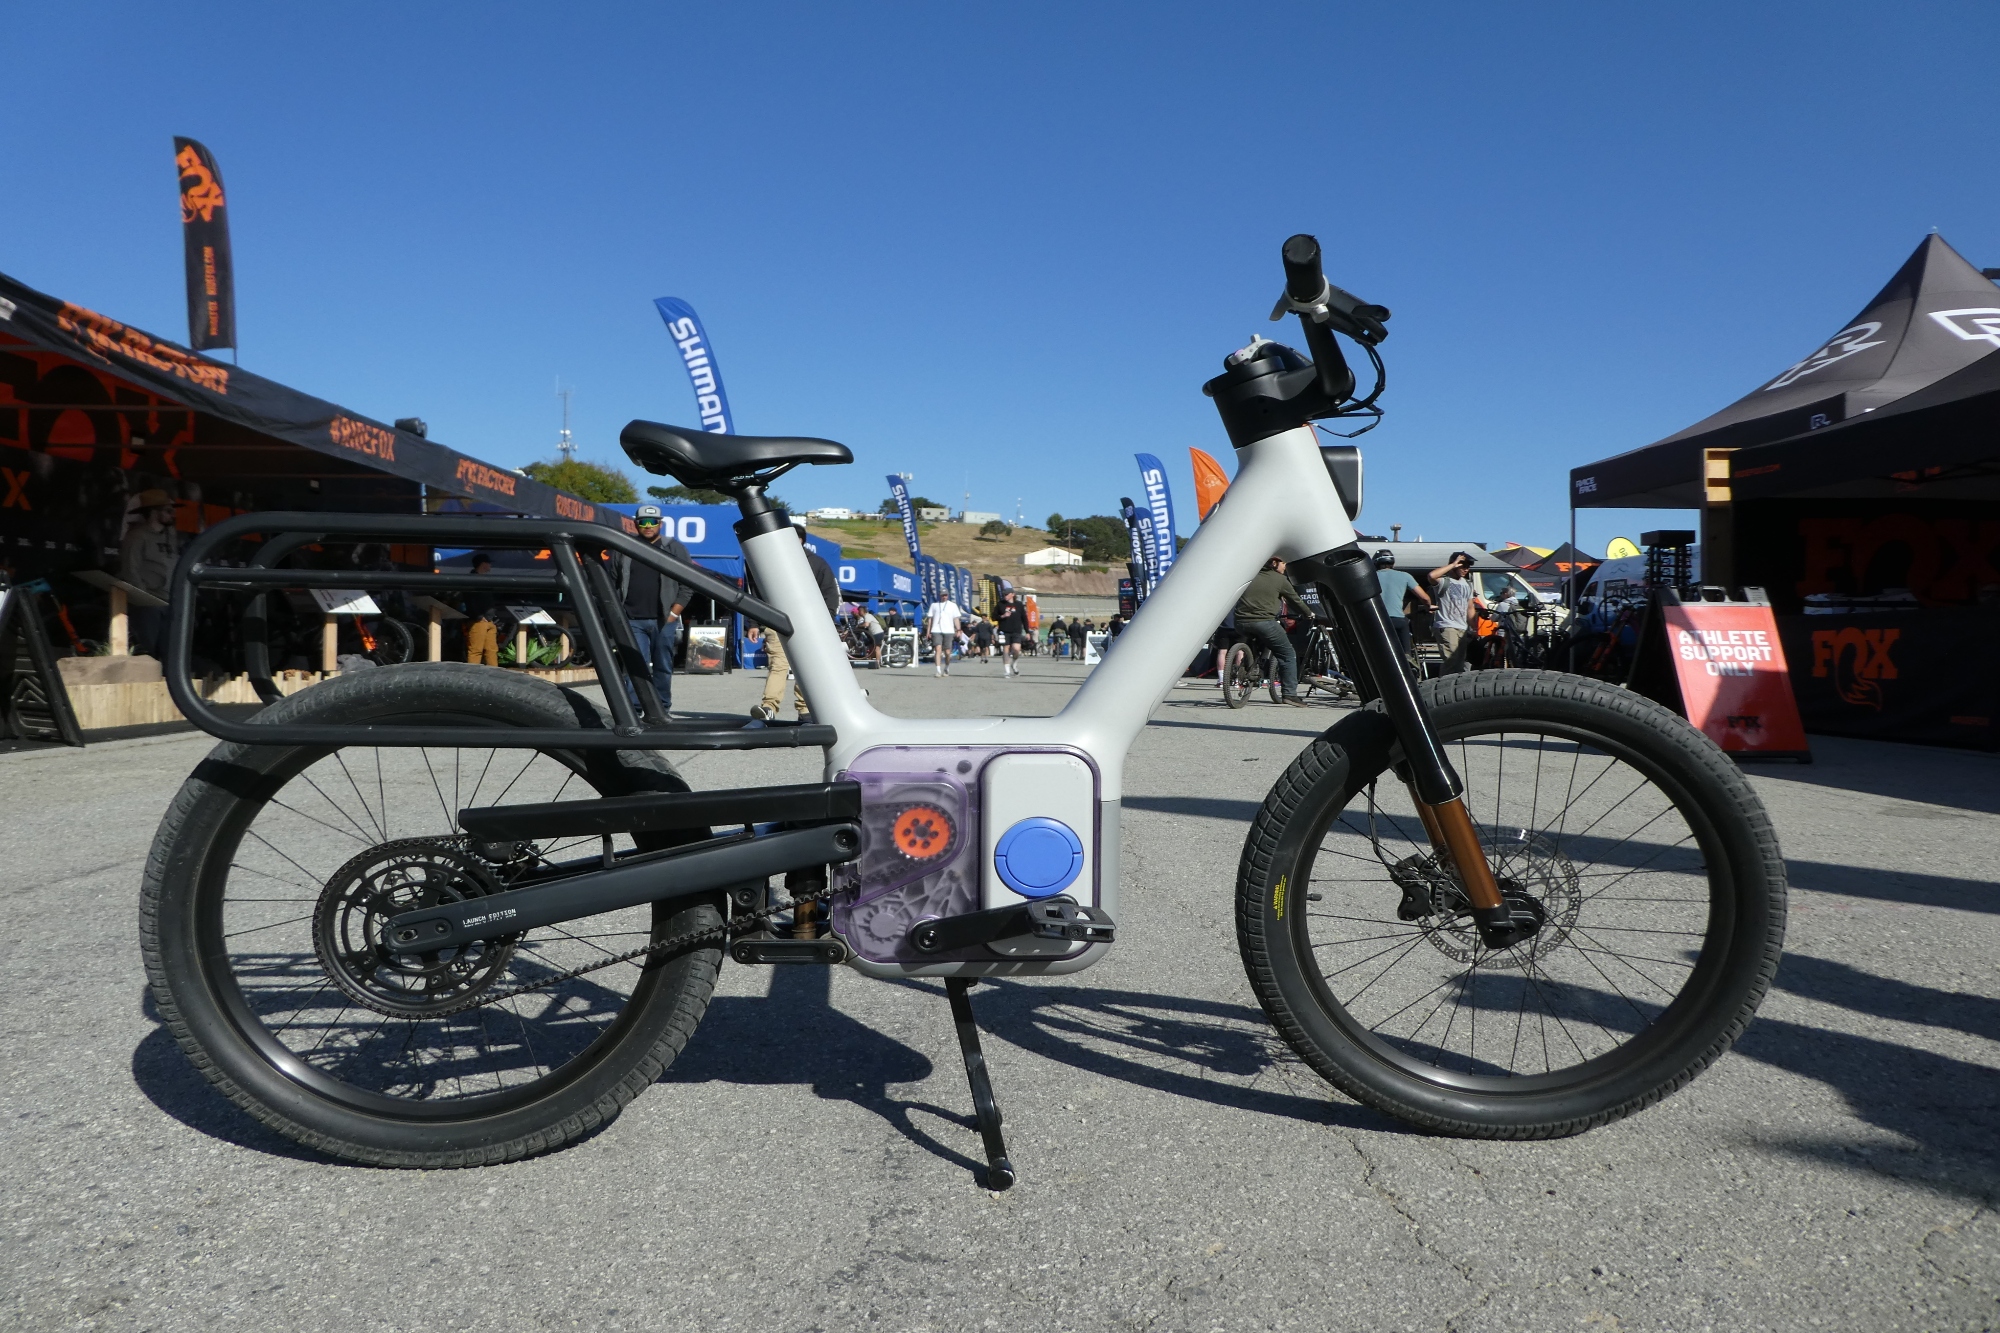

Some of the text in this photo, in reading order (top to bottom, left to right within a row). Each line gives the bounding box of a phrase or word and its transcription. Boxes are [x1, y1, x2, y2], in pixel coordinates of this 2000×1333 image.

[175, 144, 224, 223] FOX
[669, 316, 728, 435] SHIMAN
[1575, 477, 1595, 488] RACE
[1578, 483, 1598, 495] FACE
[891, 484, 918, 553] SHIMANO
[1679, 630, 1769, 646] ATHLETE
[1680, 646, 1772, 661] SUPPORT
[1811, 627, 1900, 696] FOX
[1706, 662, 1755, 677] ONLY
[1727, 716, 1762, 731] FOX
[462, 915, 487, 925] LAUNCH
[488, 908, 517, 919] EDITION
